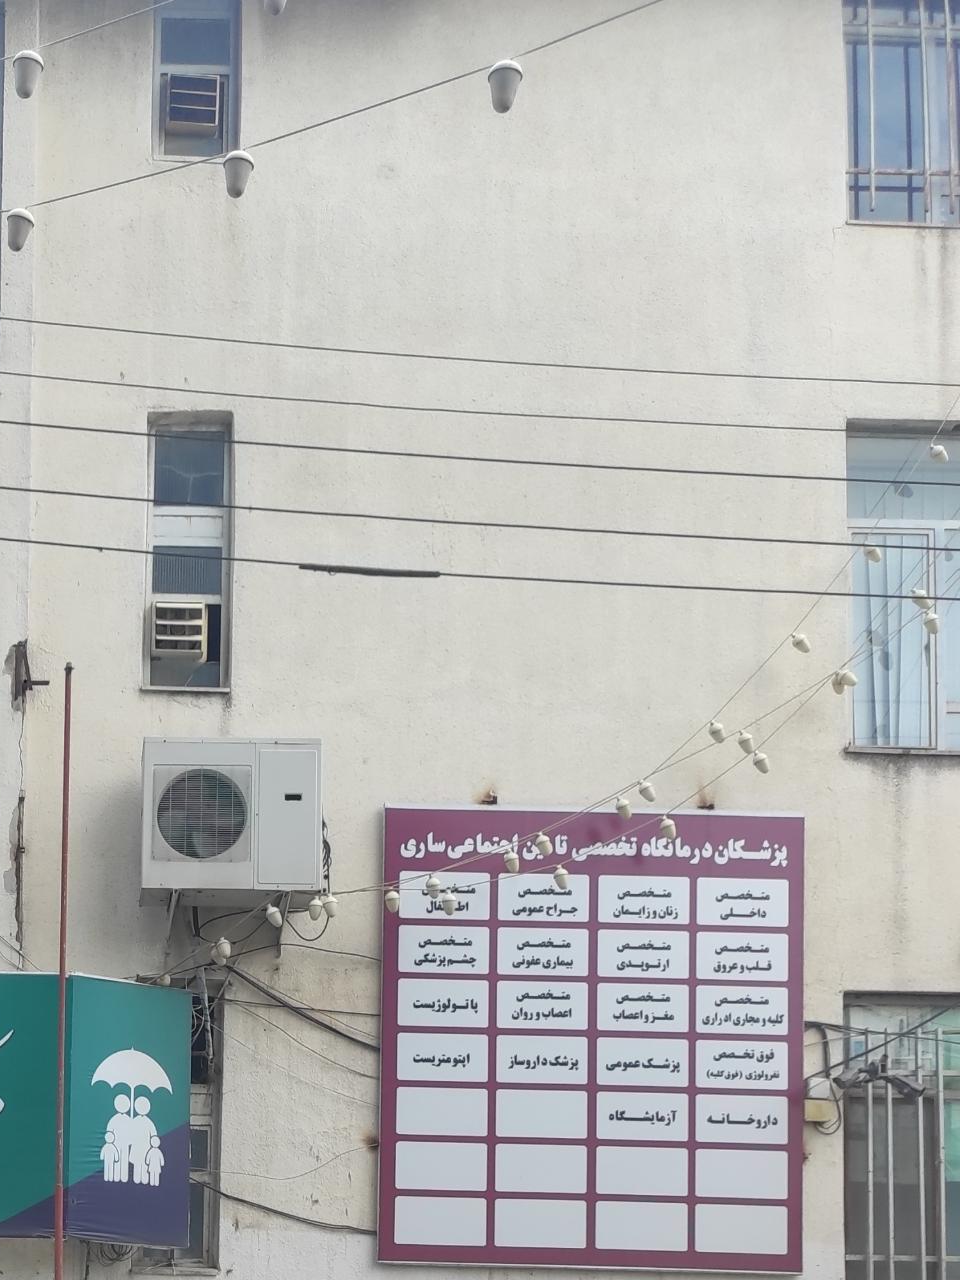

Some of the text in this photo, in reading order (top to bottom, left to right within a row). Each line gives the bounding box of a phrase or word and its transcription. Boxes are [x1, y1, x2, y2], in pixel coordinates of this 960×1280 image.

[400, 832, 446, 858] ساری
[522, 834, 568, 861] تاین
[571, 836, 638, 861] تخصصی
[714, 838, 788, 867] پزشکان
[518, 884, 573, 898] متخصص
[617, 886, 672, 900] متخصص
[715, 889, 770, 902] متخصص
[512, 903, 578, 917] جراح عمومی
[613, 905, 651, 919] زایمان
[658, 905, 679, 919] زنان
[720, 907, 767, 921] داخلی
[418, 935, 473, 948] متخصص
[516, 937, 572, 950] متخصص
[616, 939, 672, 952] متخصص
[714, 942, 770, 955] متخصص
[511, 954, 574, 970] بیماری عفونی
[713, 963, 739, 974] عروق
[746, 959, 772, 972] قلب
[515, 989, 571, 1002] متخصص
[616, 991, 671, 1004] متخصص
[714, 995, 769, 1007] متخصص
[413, 997, 478, 1014] پاتولوژیست
[511, 1007, 534, 1021] روان
[542, 1007, 572, 1019] اعصاب
[613, 1010, 643, 1022] اعصاب
[651, 1013, 675, 1023] مغز
[702, 1011, 732, 1026] ادراری
[732, 1012, 760, 1027] مجاری
[767, 1012, 785, 1026] کلیه
[413, 1053, 471, 1068] اپتومتریست
[508, 1052, 579, 1070] پزشک داروساز
[713, 1048, 775, 1063] فوق تخصص
[605, 1057, 681, 1073] پزشک عمومی
[609, 1110, 678, 1126] آزمایشگاه
[707, 1113, 778, 1129] داروخانه
